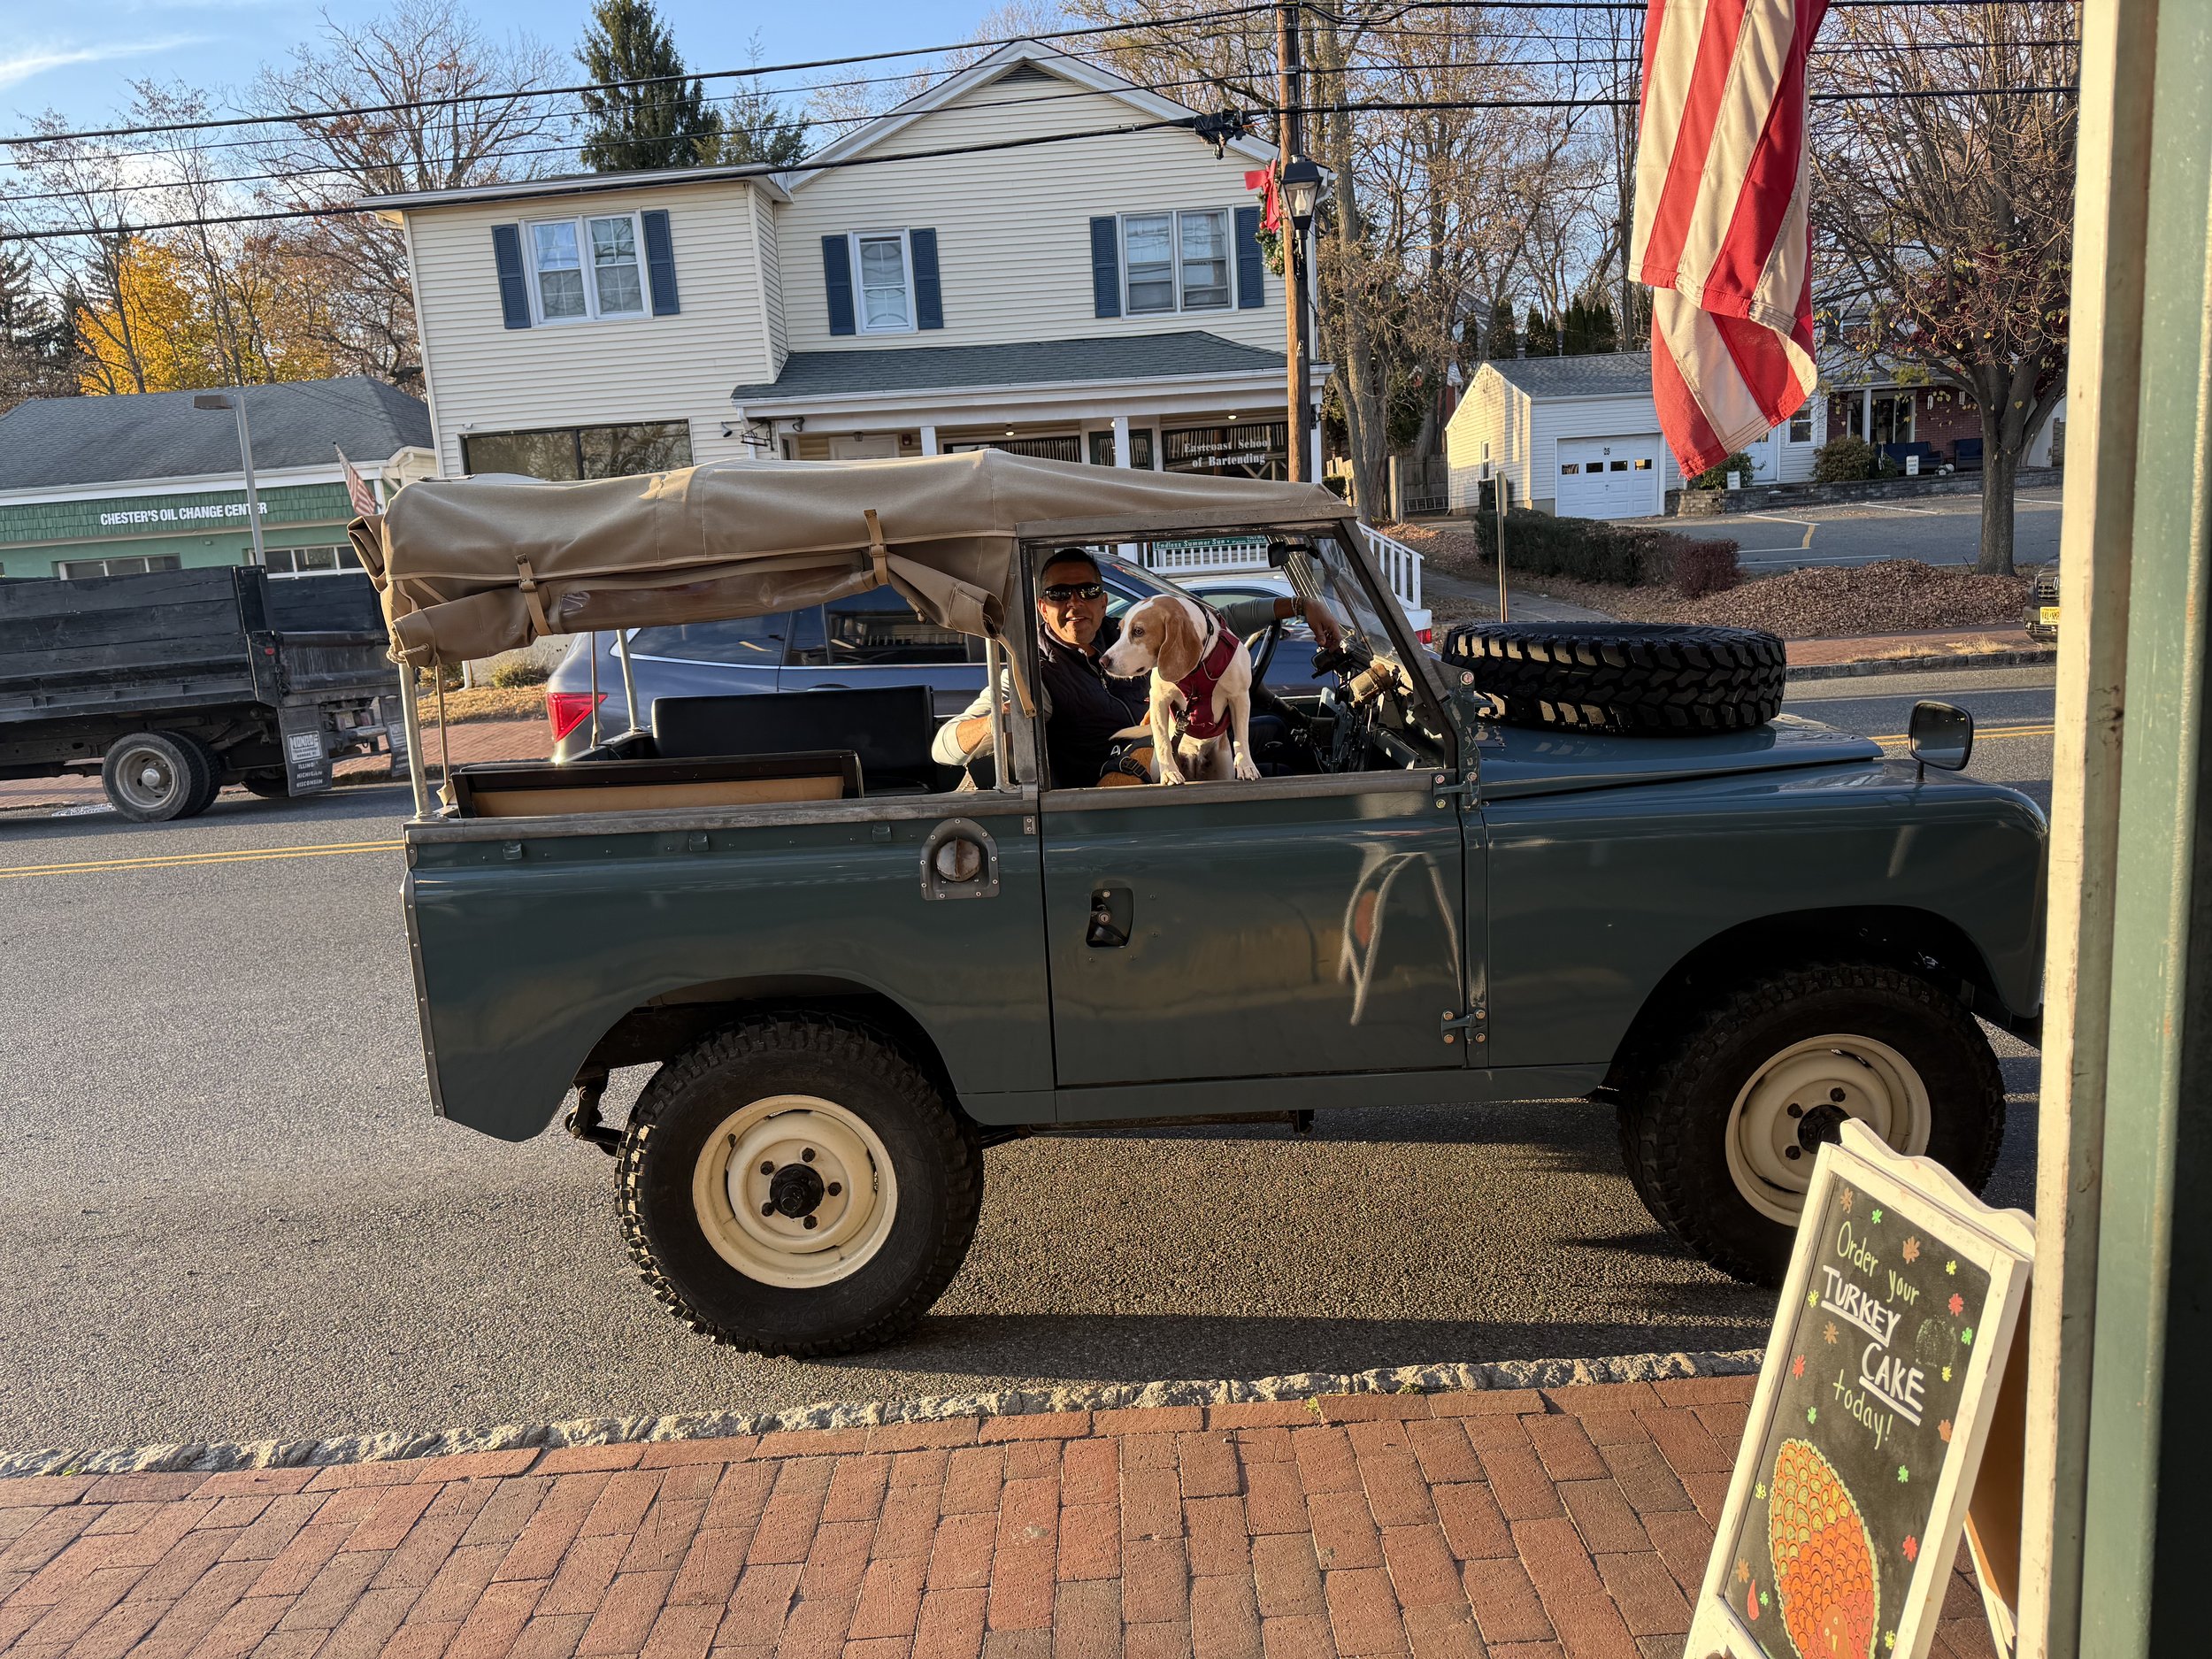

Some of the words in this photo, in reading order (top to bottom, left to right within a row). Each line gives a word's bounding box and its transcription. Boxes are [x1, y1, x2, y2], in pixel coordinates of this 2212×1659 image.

[1184, 442, 1233, 453] Eastcoast
[1238, 438, 1271, 449] School
[1192, 457, 1202, 467] of
[1208, 453, 1266, 466] Bartending
[100, 509, 158, 526] CHESTER'S
[159, 508, 178, 521] OIL
[179, 505, 224, 519] CHANGE
[1183, 539, 1210, 548] Summer
[1837, 1220, 1878, 1278] Order
[1886, 1269, 1920, 1306] your
[1823, 1264, 1901, 1342] TURKEY
[1862, 1342, 1925, 1412] CAKE
[1832, 1369, 1893, 1450] today!
